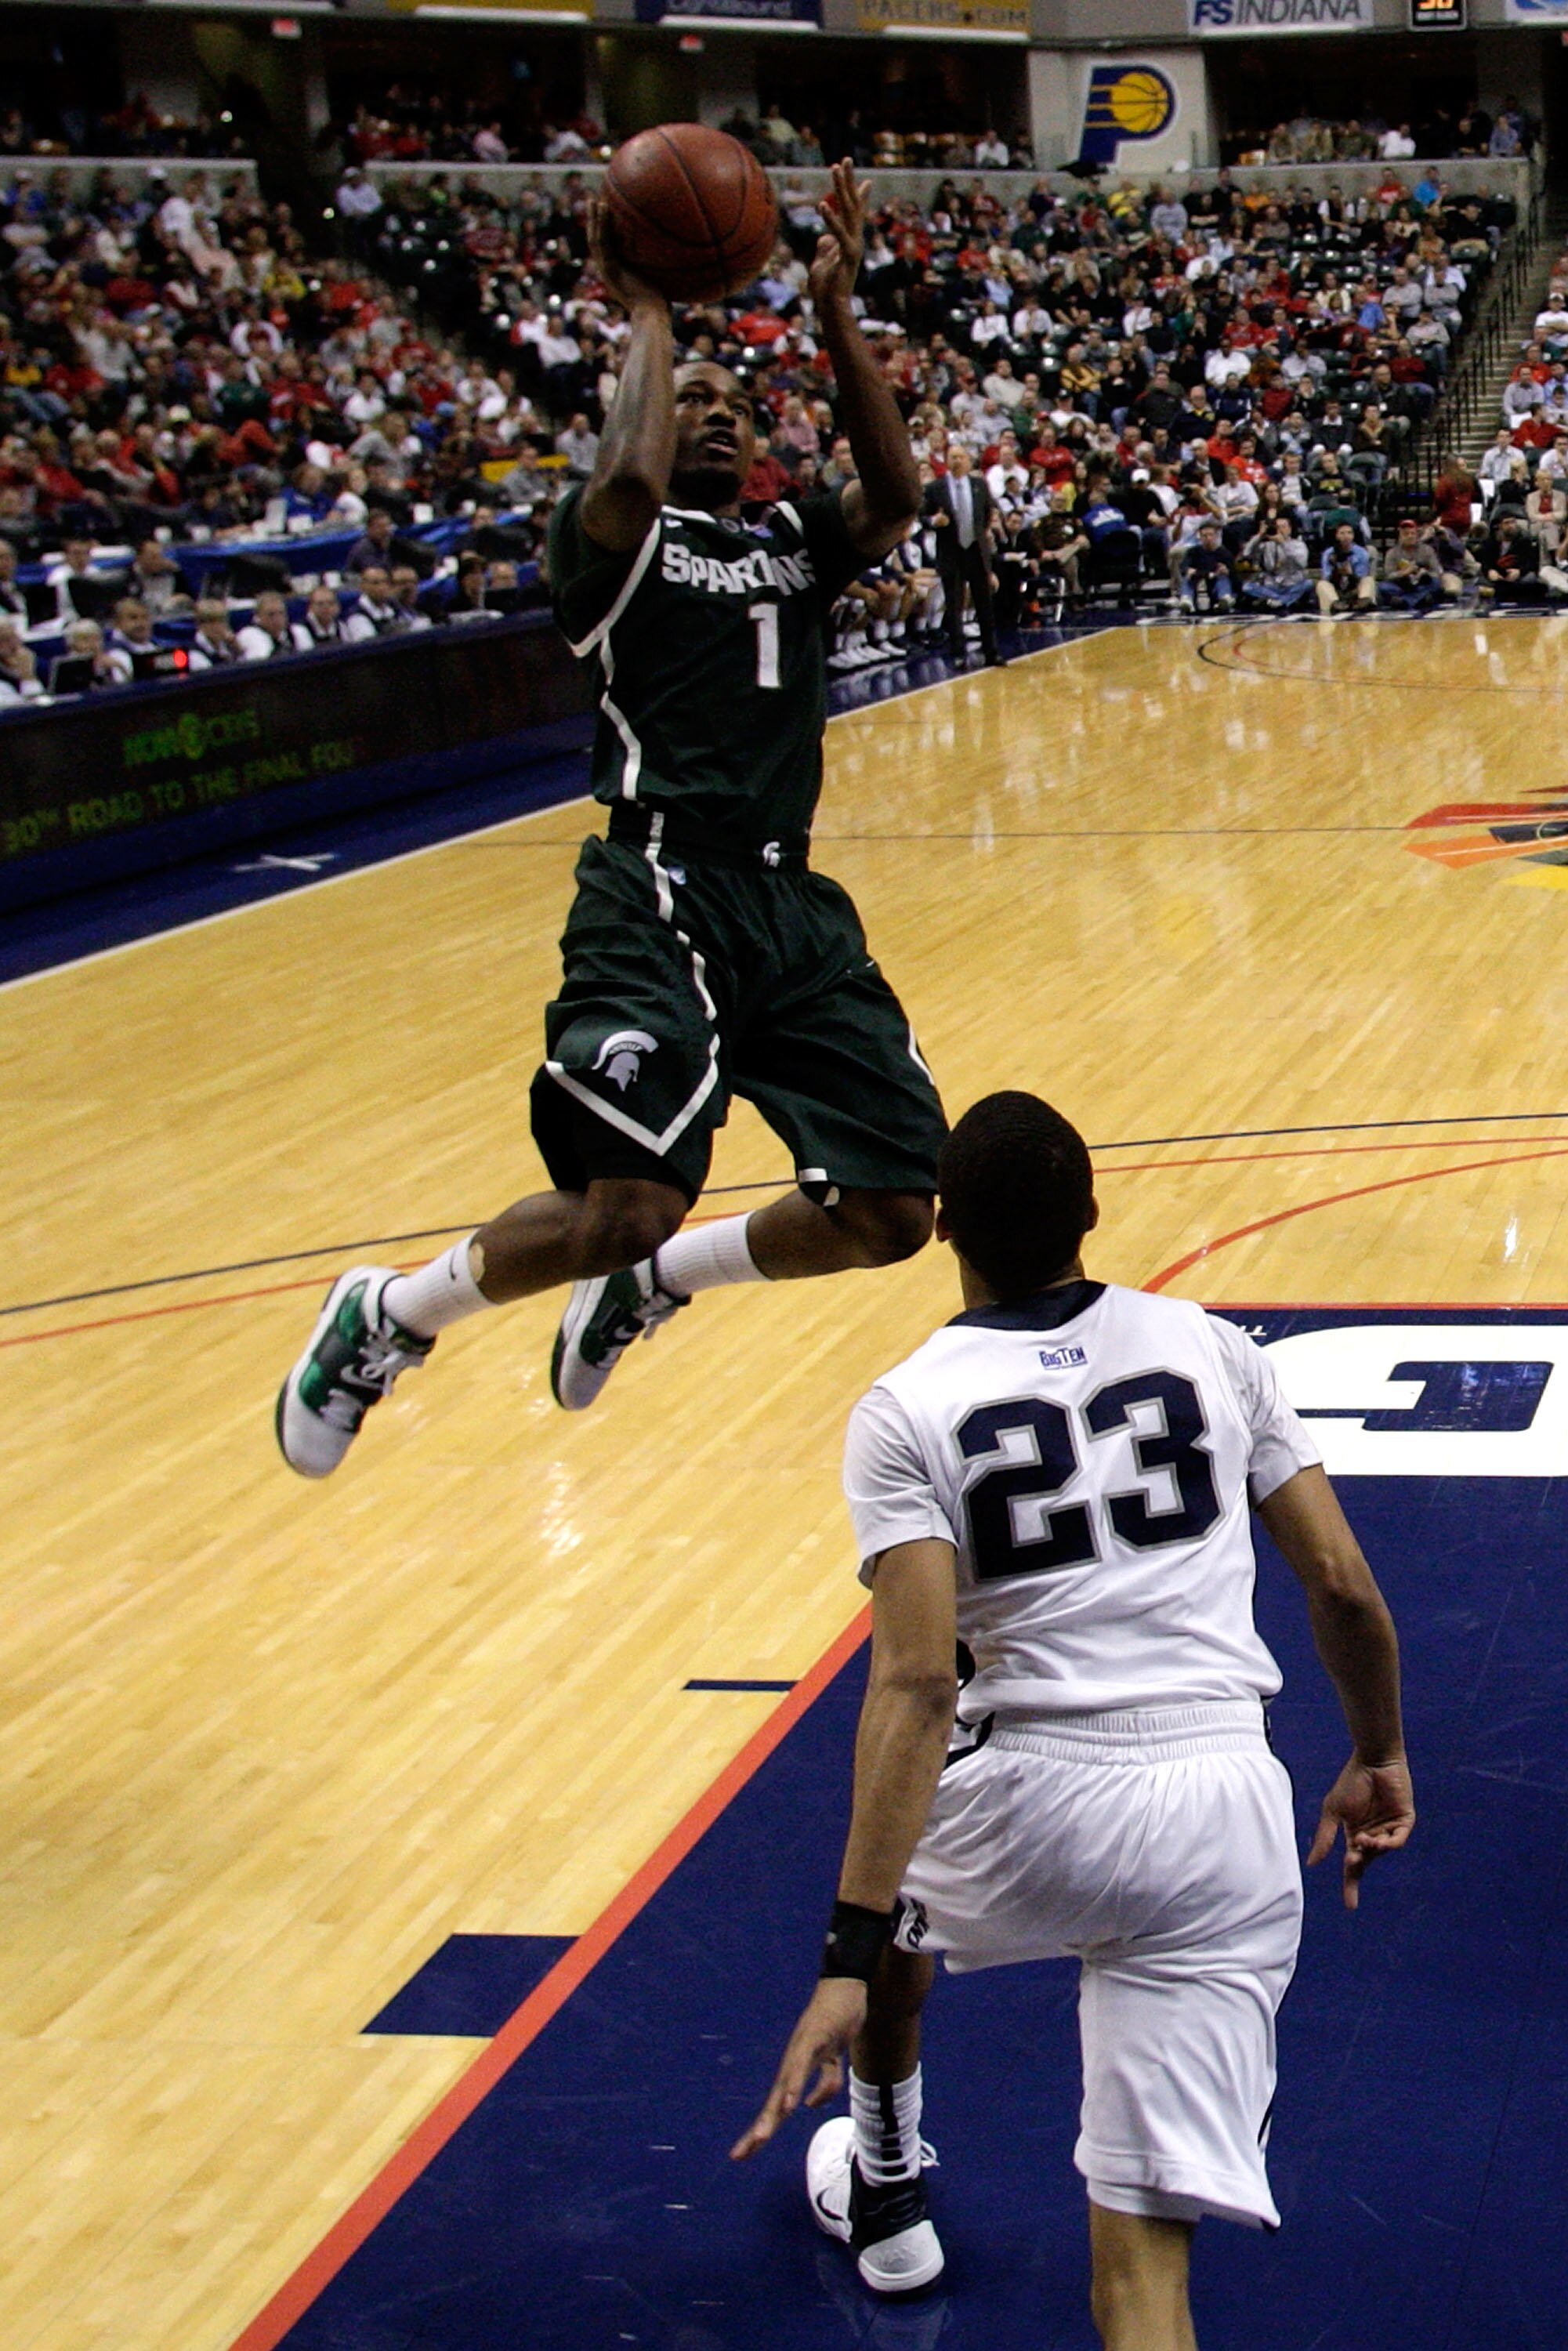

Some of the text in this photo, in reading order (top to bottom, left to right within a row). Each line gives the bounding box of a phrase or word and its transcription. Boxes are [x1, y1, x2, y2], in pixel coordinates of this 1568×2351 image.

[1193, 0, 1361, 27] FS INDIANA
[748, 603, 781, 689] 1
[67, 789, 144, 834] ROAD
[150, 779, 186, 811] TO
[190, 766, 239, 804] THE
[951, 1365, 1227, 1583] 23
